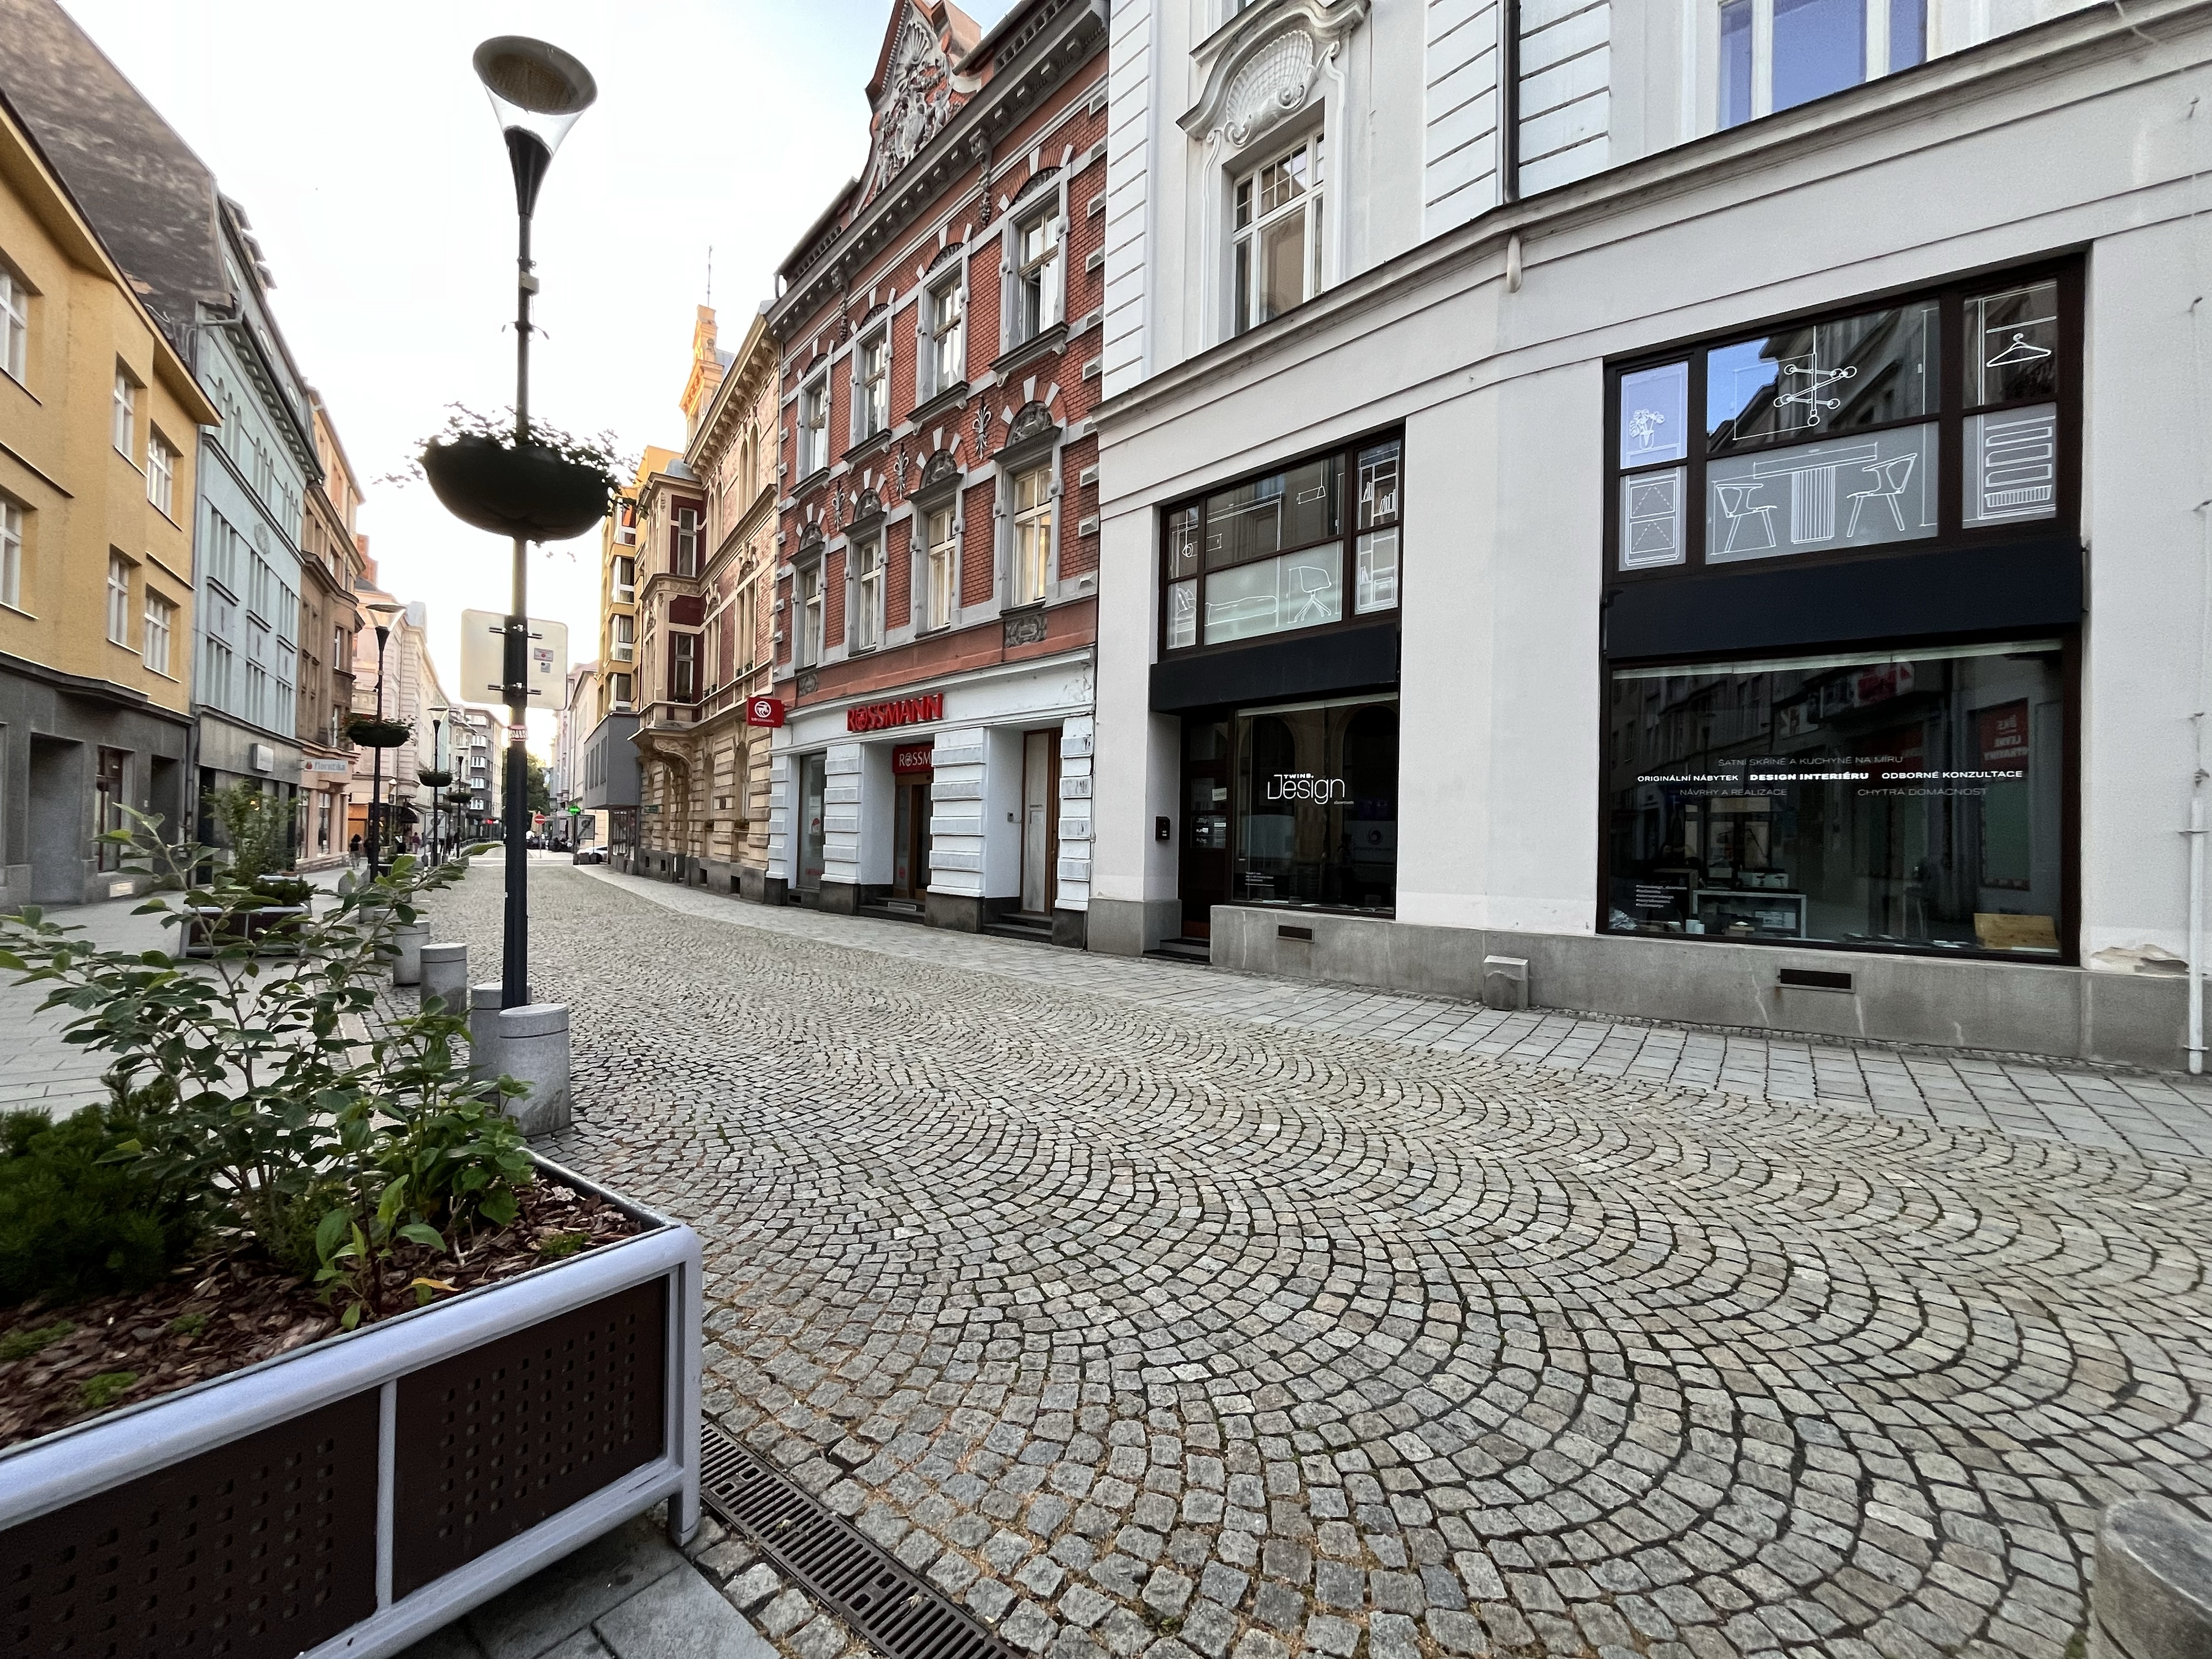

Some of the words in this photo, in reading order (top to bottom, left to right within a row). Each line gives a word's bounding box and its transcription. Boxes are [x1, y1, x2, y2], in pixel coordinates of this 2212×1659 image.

[847, 692, 943, 733] ROSSMANN
[1718, 758, 1747, 766] ŠATNÍ
[1799, 771, 1869, 780] INTERIÉRU
[1881, 770, 1939, 780] ODBORNÉ
[1942, 770, 2023, 779] KONZULTACE
[1857, 787, 1906, 796] CHYTRÁ
[1908, 787, 1988, 796] DOMÁCNOST
